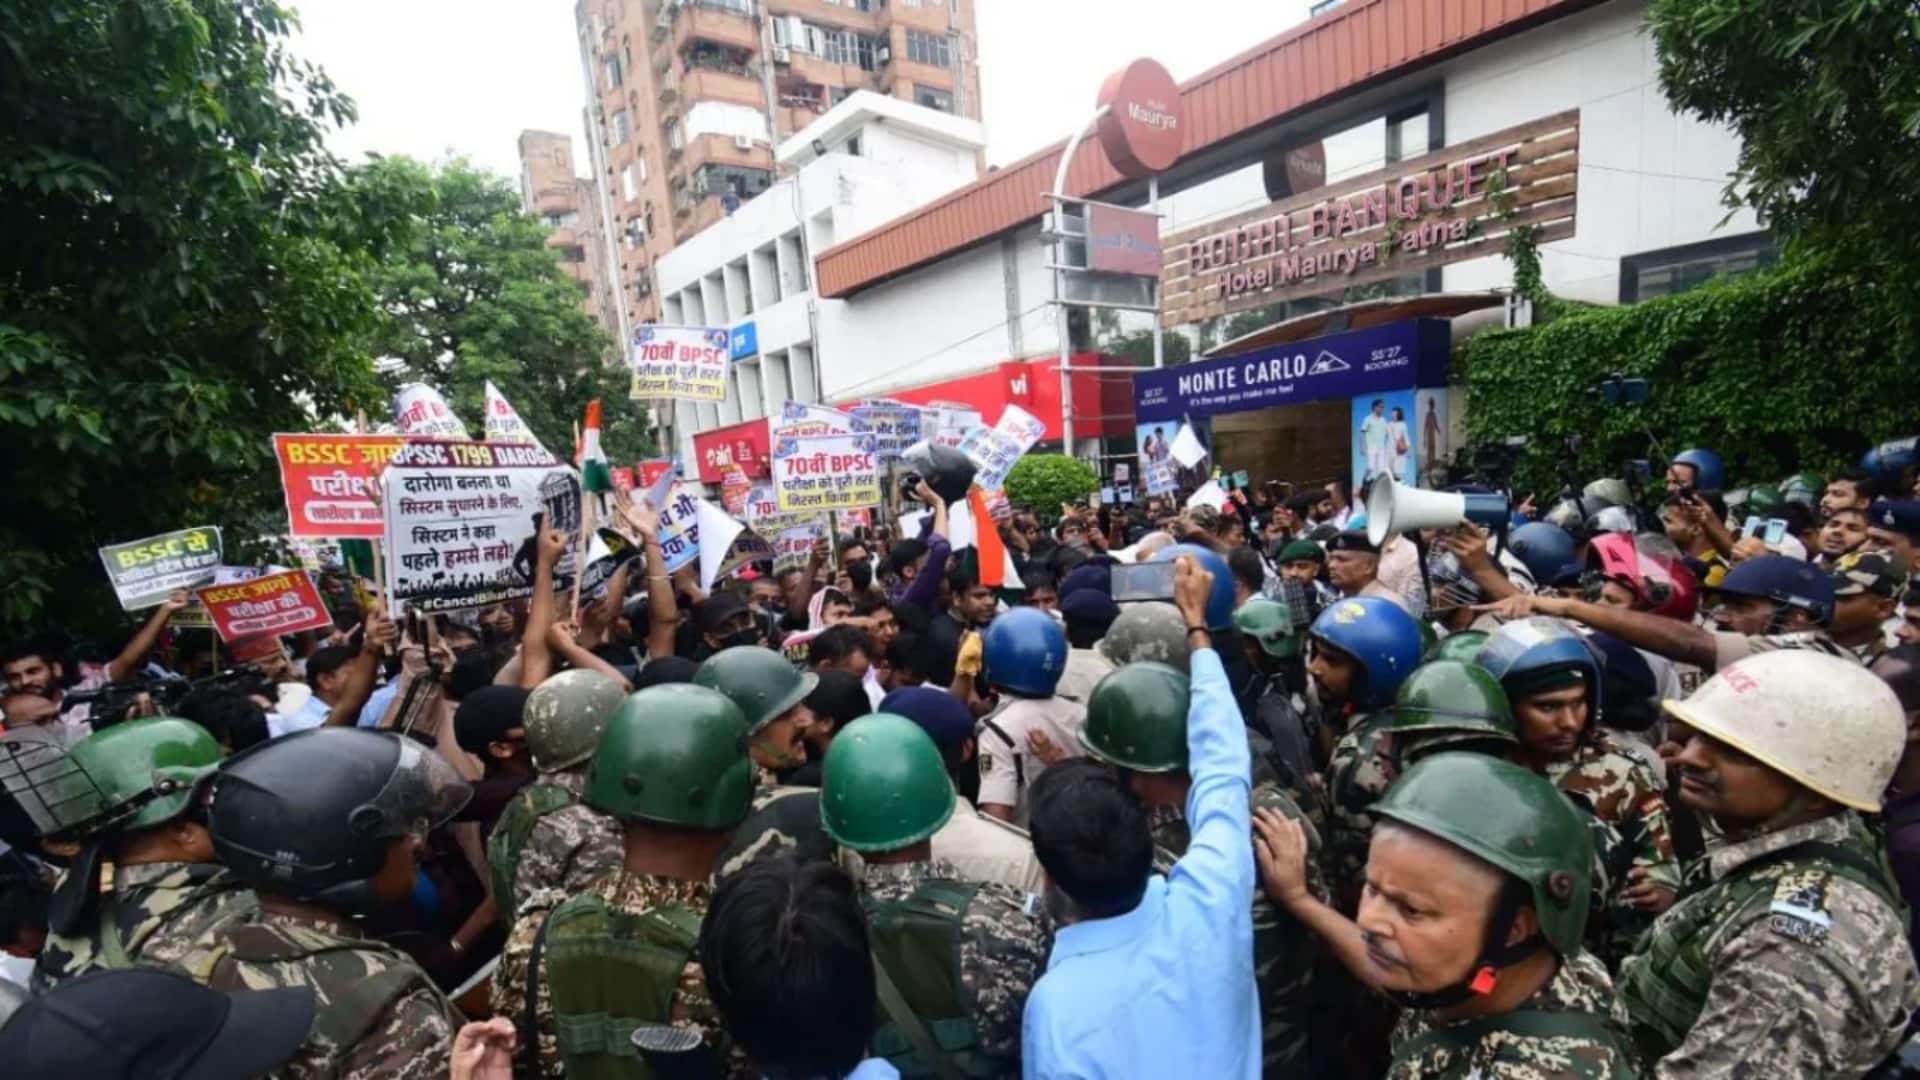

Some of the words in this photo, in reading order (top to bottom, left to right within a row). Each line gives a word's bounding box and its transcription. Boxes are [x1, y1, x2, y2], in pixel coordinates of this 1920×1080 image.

[1129, 102, 1177, 129] Maurya
[1186, 213, 1292, 276] BODHI
[1307, 151, 1519, 241] BANQUET
[1215, 267, 1273, 299] Hotel
[1280, 240, 1376, 281] Maurya
[680, 345, 724, 365] BPSC
[1010, 372, 1027, 395] vi
[1178, 368, 1236, 397] MONTE
[1245, 354, 1307, 385] CARLO
[287, 441, 352, 466] BSSC
[451, 445, 495, 466] 1799
[495, 446, 557, 466] DAROGA
[831, 452, 873, 473] BPSC
[402, 472, 453, 493] दारोगा
[399, 498, 443, 516] सिस्टम
[486, 496, 498, 511] के
[412, 525, 458, 545] सिस्टम
[460, 522, 470, 541] ने
[473, 524, 496, 541] कहा
[116, 539, 183, 569] BSSC
[401, 547, 439, 571] पहले
[444, 543, 480, 569] हमसे
[205, 587, 248, 604] BSSC
